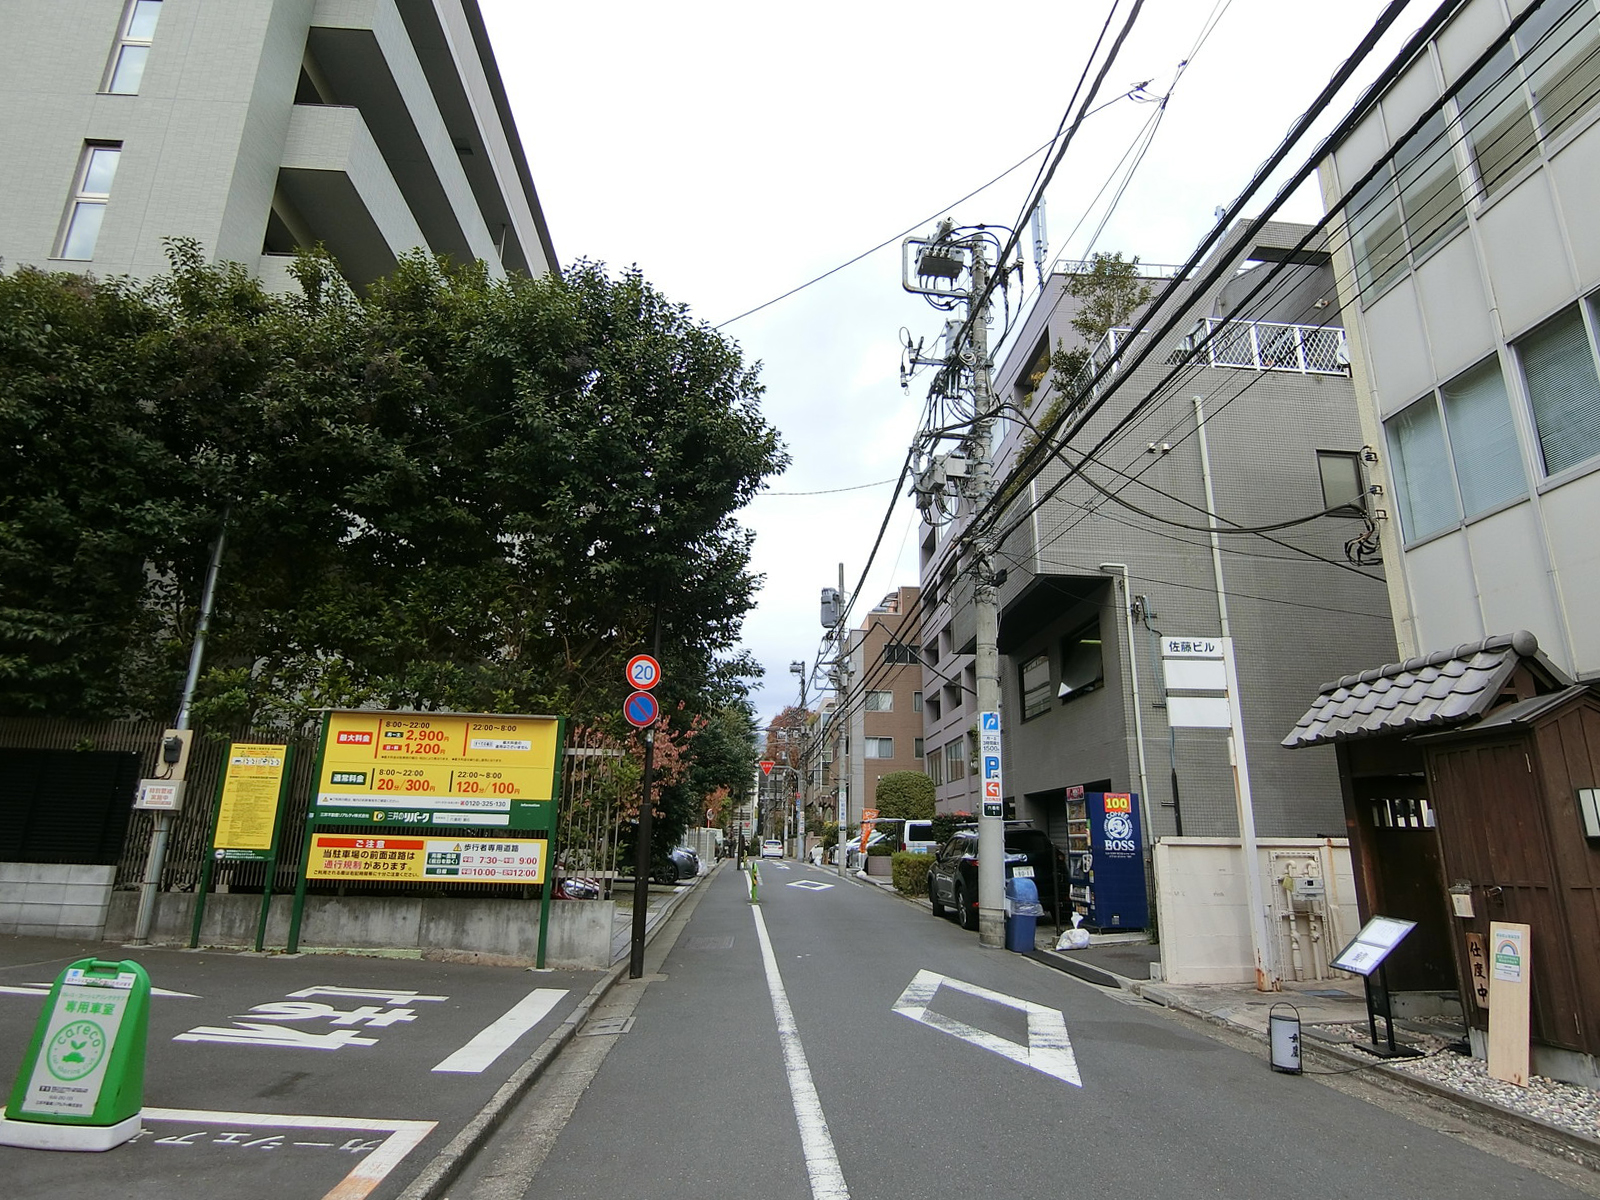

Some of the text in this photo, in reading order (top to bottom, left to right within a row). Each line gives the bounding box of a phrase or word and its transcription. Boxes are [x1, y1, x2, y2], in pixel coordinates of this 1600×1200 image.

[1169, 641, 1214, 652] 佐藤ビル
[634, 664, 653, 680] 20
[339, 734, 370, 742] 最大料金
[406, 730, 449, 742] 2,900円
[405, 743, 445, 754] 1,200円
[985, 756, 999, 779] P
[333, 774, 364, 783] 通常料金
[1106, 798, 1128, 809] 100
[387, 811, 430, 823] 三井のリパーク
[356, 840, 386, 849] ご注意
[464, 844, 519, 852] 歩行者専用道路
[1104, 840, 1135, 851] BOSS
[322, 849, 415, 860] 当駐車場の前面道路は
[518, 857, 538, 865] 9:00
[1470, 941, 1488, 1003] 仕度中
[65, 1000, 116, 1016] 専用車室
[57, 1024, 101, 1048] careco
